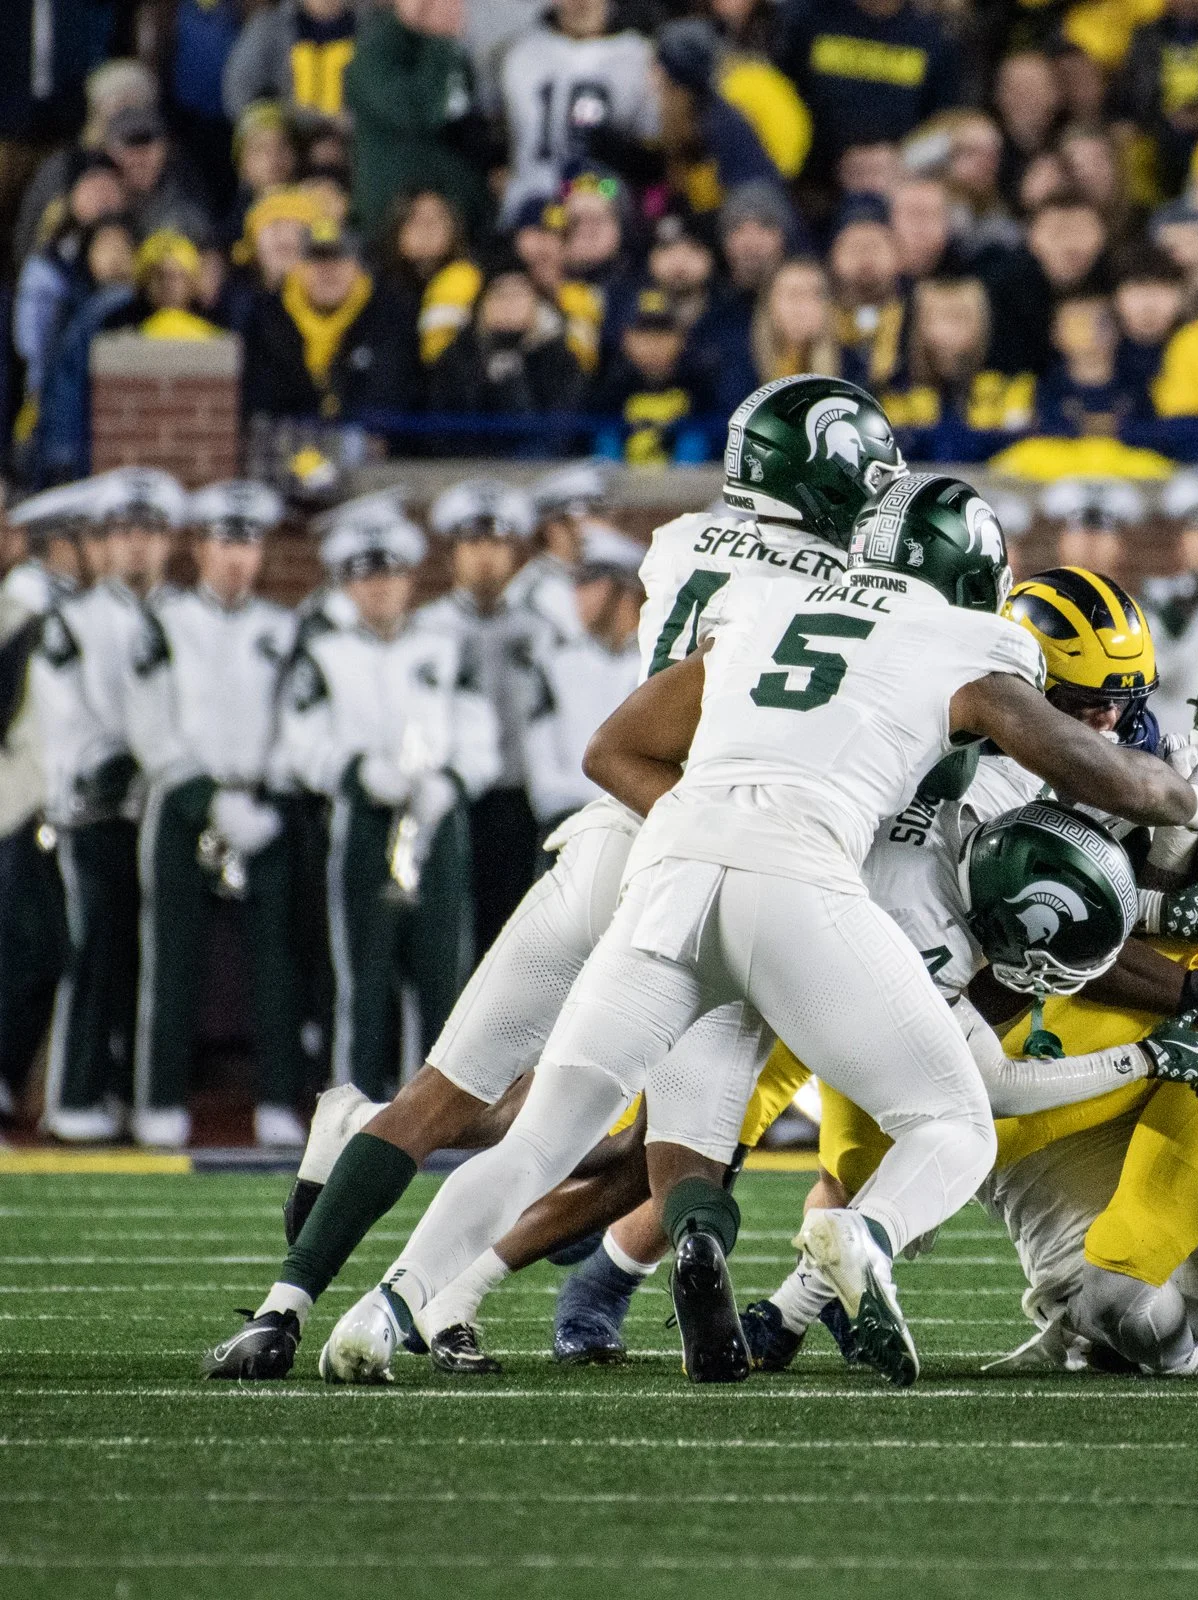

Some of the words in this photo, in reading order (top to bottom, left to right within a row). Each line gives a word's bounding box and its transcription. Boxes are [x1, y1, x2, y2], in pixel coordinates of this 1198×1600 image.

[693, 527, 837, 581] SPENCER
[804, 584, 892, 614] HALL
[850, 574, 908, 594] SPARTANS
[749, 613, 876, 712] 5
[1121, 675, 1135, 688] M
